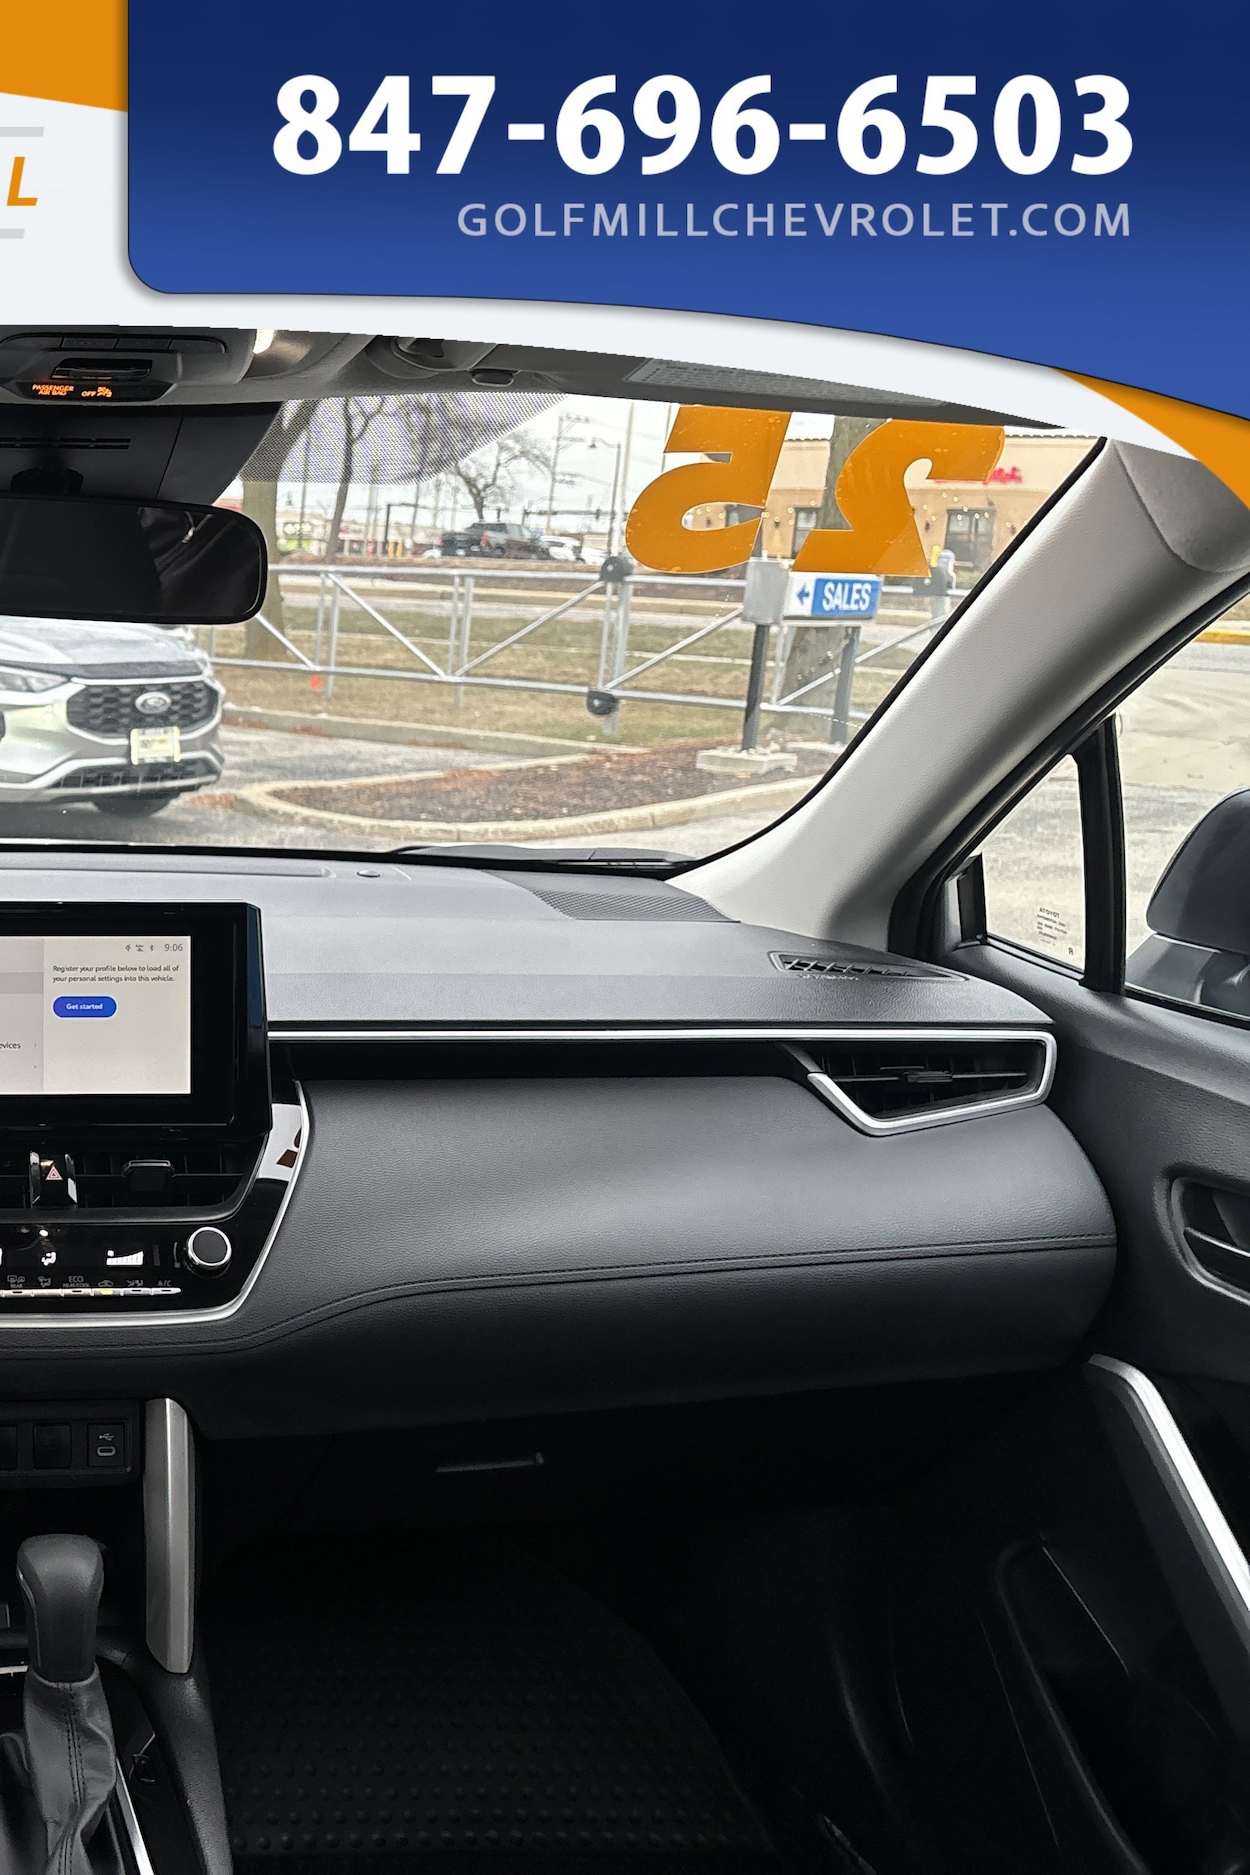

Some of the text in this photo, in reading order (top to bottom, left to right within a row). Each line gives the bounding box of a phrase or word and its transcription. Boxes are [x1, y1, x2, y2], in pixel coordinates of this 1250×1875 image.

[32, 383, 74, 392] PASSENGER
[822, 581, 872, 611] SALES
[53, 965, 78, 973] Register
[95, 965, 116, 973] profile
[68, 975, 97, 983] personal
[98, 975, 123, 983] settings
[68, 1275, 84, 1283] ECO
